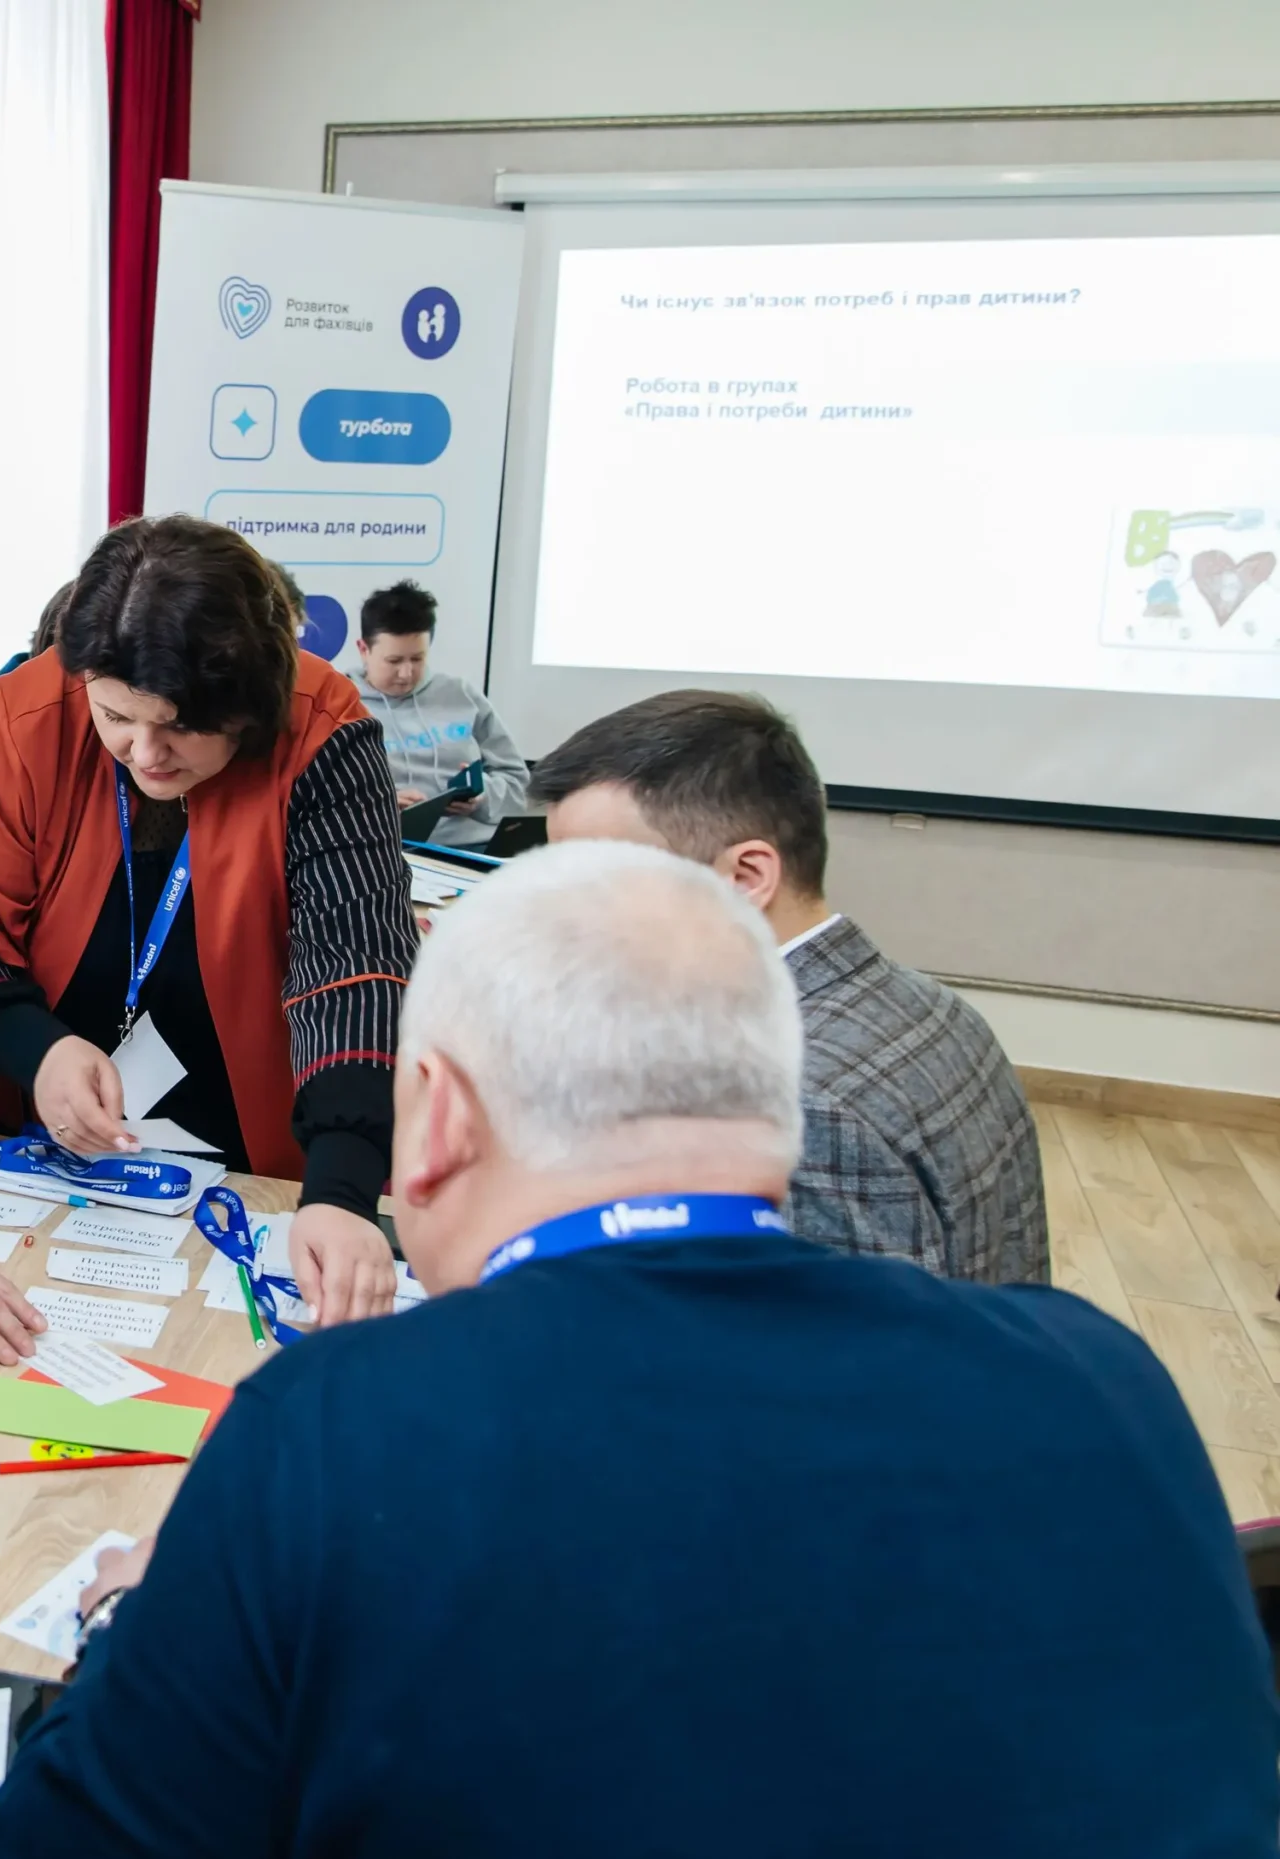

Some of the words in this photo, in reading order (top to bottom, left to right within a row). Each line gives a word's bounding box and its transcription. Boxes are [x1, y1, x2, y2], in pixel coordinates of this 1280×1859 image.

[286, 298, 350, 314] Розвиток
[621, 294, 649, 309] Чи
[656, 294, 714, 312] існує
[723, 292, 807, 308] зв'язок
[814, 291, 894, 309] потреб
[901, 290, 908, 306] і
[915, 292, 972, 309] прав
[978, 288, 1082, 307] дитини?
[284, 316, 309, 328] для
[313, 317, 374, 333] фахівців
[625, 377, 701, 394] Робота
[707, 380, 720, 394] в
[726, 380, 799, 397] групах
[624, 402, 700, 421] «Права
[706, 402, 713, 418] і
[719, 402, 808, 422] потреби
[819, 405, 914, 421] дитини»
[339, 417, 413, 437] турбота
[324, 520, 355, 535] для
[361, 522, 427, 537] родини
[120, 794, 129, 828] unicef
[164, 879, 182, 911] unicef
[72, 1219, 134, 1235] Потреба
[138, 1230, 174, 1242] бути
[74, 1229, 161, 1248] захищеною
[75, 1265, 161, 1282] отриманні
[81, 1257, 147, 1271] Потреба
[71, 1272, 160, 1291] інформації
[58, 1295, 122, 1312] Потреба
